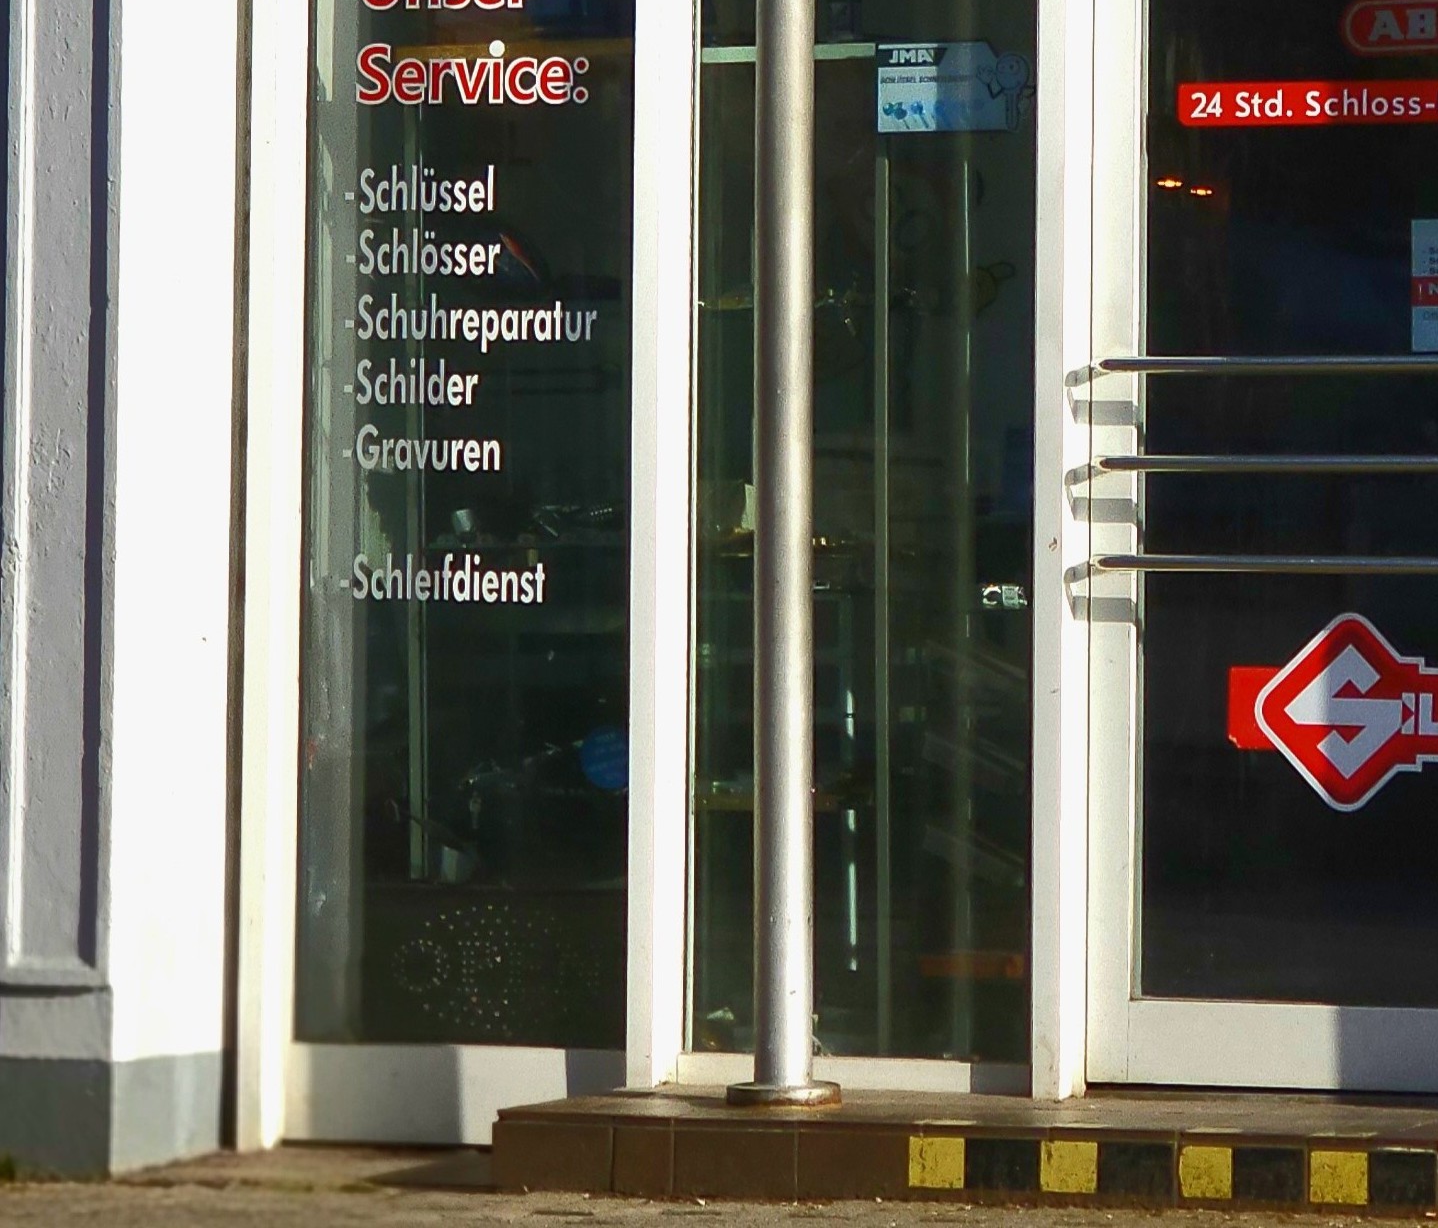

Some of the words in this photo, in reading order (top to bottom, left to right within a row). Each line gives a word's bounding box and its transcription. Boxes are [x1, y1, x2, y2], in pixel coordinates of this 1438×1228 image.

[888, 49, 934, 64] JMA
[356, 39, 590, 105] Service:
[1190, 91, 1223, 118] 24
[1235, 90, 1293, 118] Std.
